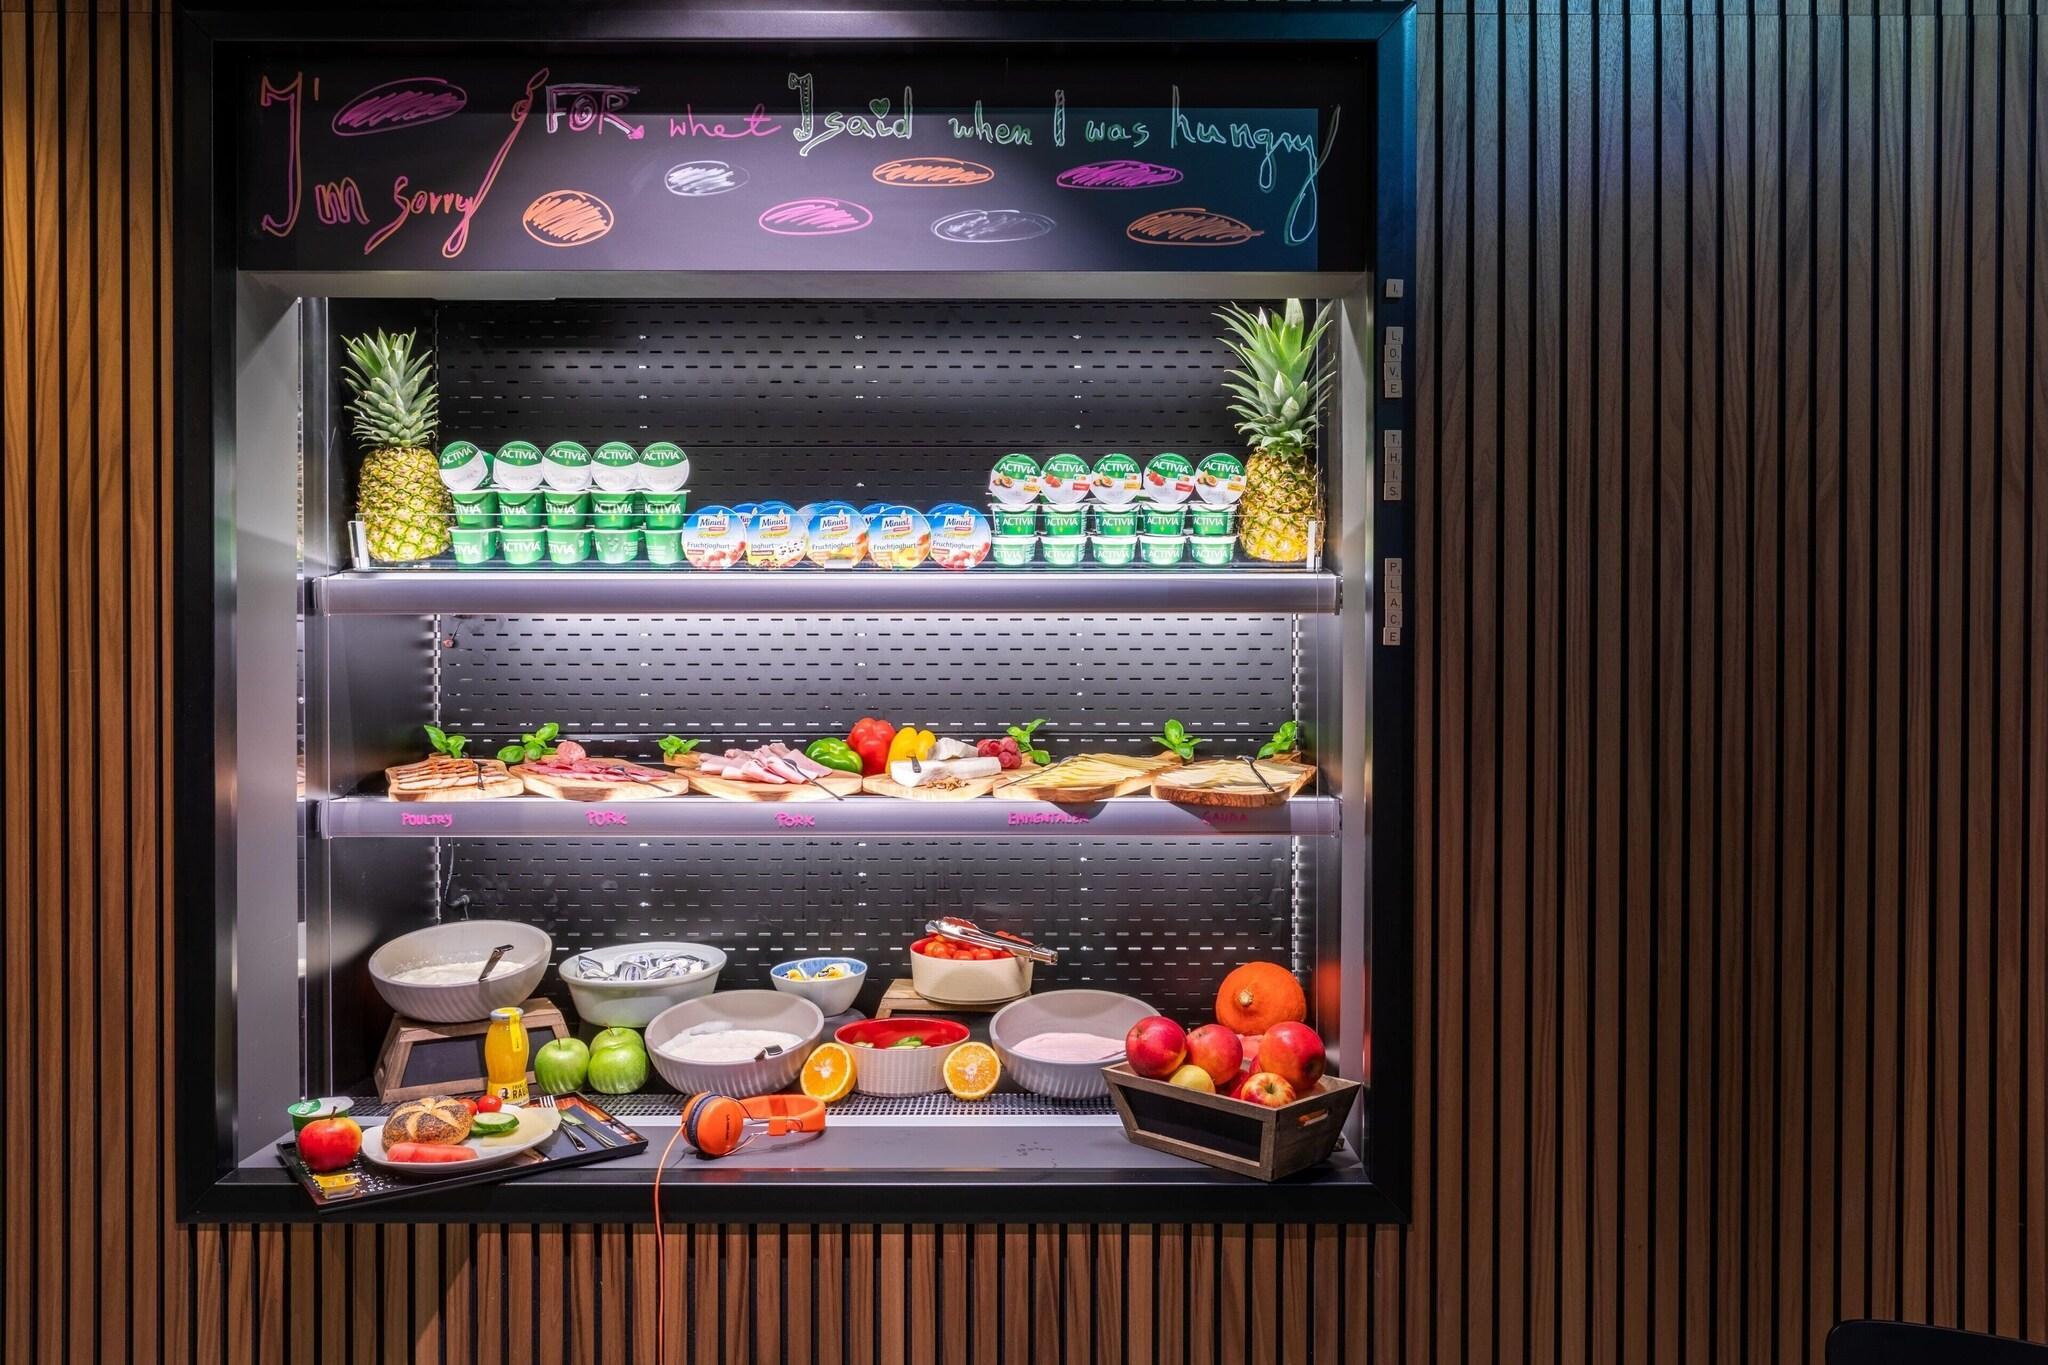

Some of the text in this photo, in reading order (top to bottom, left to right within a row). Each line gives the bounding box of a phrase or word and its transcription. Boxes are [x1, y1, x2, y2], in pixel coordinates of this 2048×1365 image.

[546, 84, 645, 140] FOR
[800, 86, 914, 157] said
[949, 100, 1033, 145] when
[1053, 89, 1066, 147] I
[1085, 117, 1151, 148] was
[1171, 84, 1342, 247] hungry
[442, 447, 473, 466] ACTIVIA
[501, 449, 538, 461] ACTIVIA
[549, 449, 587, 462] ACTIVIA
[597, 450, 634, 461] ACTIVIA
[643, 451, 681, 462] ACTIVIA
[999, 462, 1036, 475] ACTIVIA
[1047, 463, 1085, 474] ACTIVIA
[1099, 463, 1135, 473] ACTIVIA
[1152, 461, 1189, 474] ACTIVIA
[1203, 462, 1240, 474] ACTIVIA
[454, 504, 482, 514] TIVIA
[594, 503, 633, 513] ACTIVIA
[1102, 517, 1134, 526] ACTIVIA
[1147, 516, 1179, 526] ACTIVIA
[400, 812, 453, 828] POULTRY
[585, 810, 628, 826] PORK
[774, 811, 816, 827] PORK
